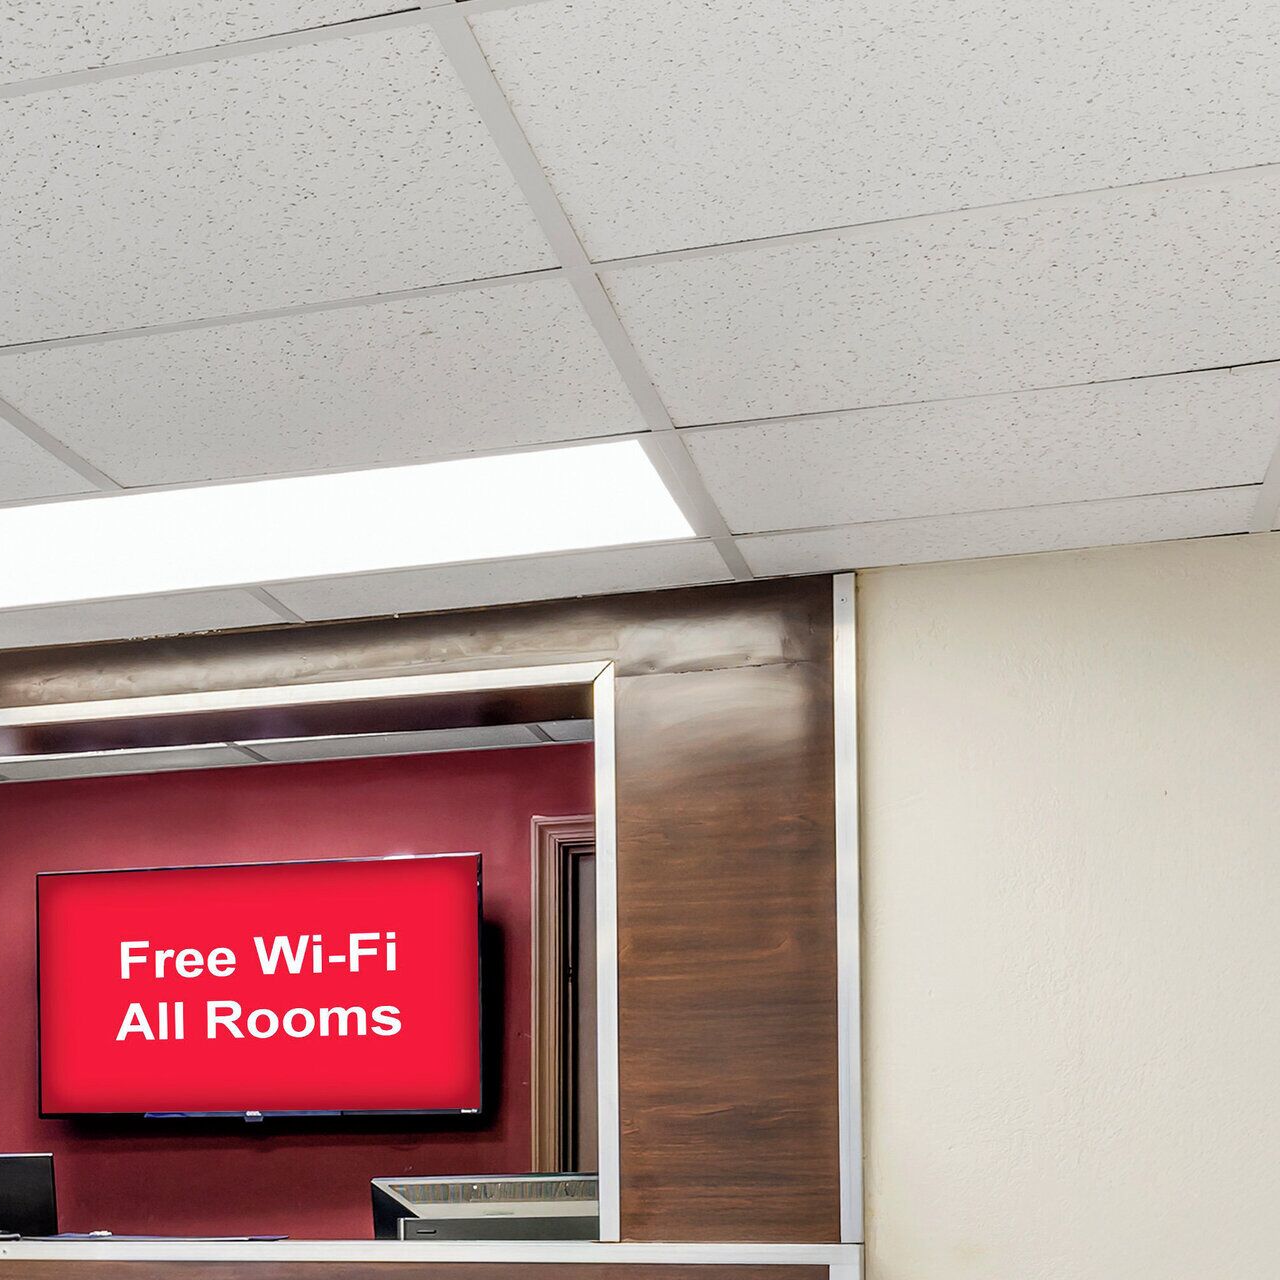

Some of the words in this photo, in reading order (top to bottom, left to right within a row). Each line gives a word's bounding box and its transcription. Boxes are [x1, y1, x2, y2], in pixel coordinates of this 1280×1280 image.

[120, 940, 237, 980] Free
[253, 931, 397, 975] Wi-Fi
[115, 1002, 185, 1041] All
[206, 999, 402, 1039] Rooms
